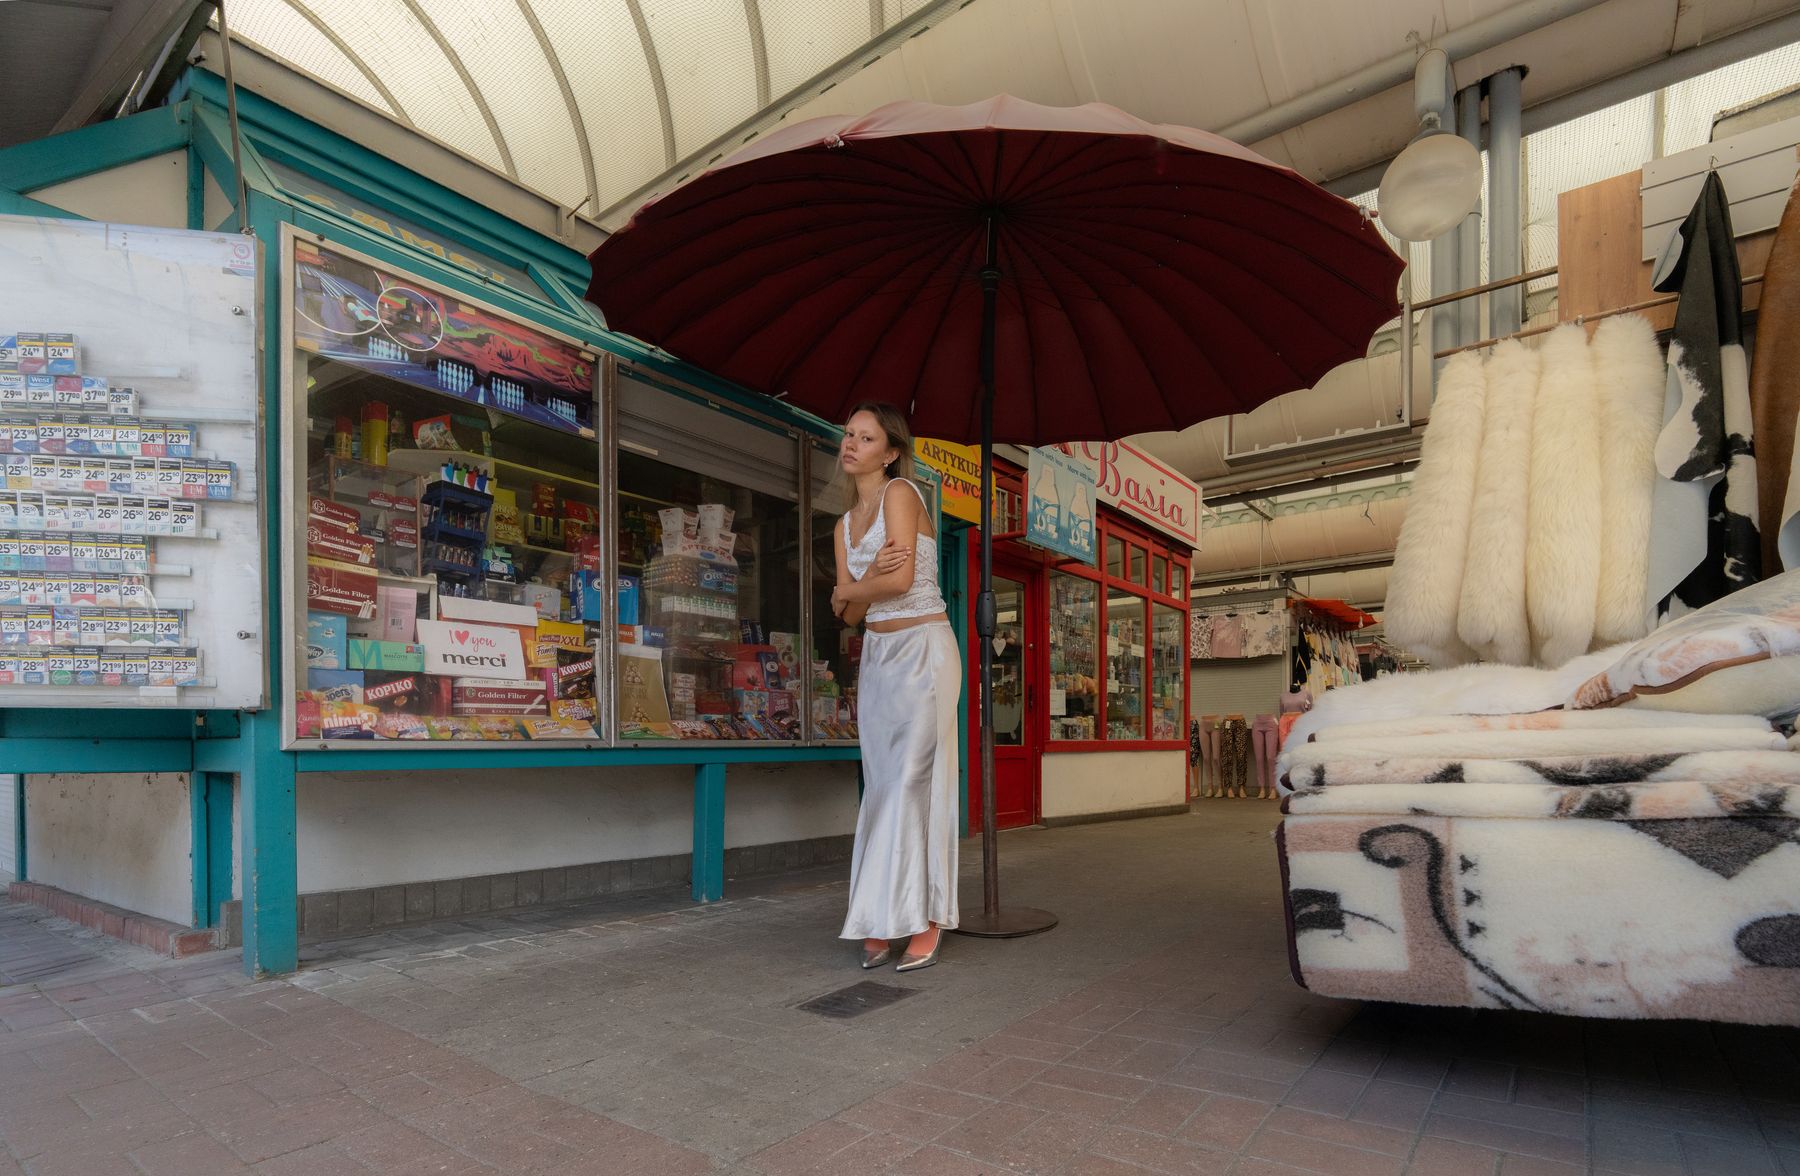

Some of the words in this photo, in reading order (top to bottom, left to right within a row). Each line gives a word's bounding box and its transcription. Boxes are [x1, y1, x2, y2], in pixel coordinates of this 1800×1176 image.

[922, 440, 981, 479] ARTYKUŁ
[1081, 440, 1188, 527] Basia
[326, 507, 343, 516] Golden
[322, 533, 344, 544] Golden
[346, 538, 361, 547] Filter
[321, 585, 350, 597] Golden
[351, 590, 371, 600] Filter
[448, 629, 454, 644] I
[471, 635, 497, 652] you
[560, 636, 583, 647] XXL
[442, 653, 507, 668] merci
[560, 660, 593, 676] KOPIKO
[365, 679, 413, 700] KOPIKO
[478, 691, 506, 699] Golden
[507, 692, 527, 700] Filter
